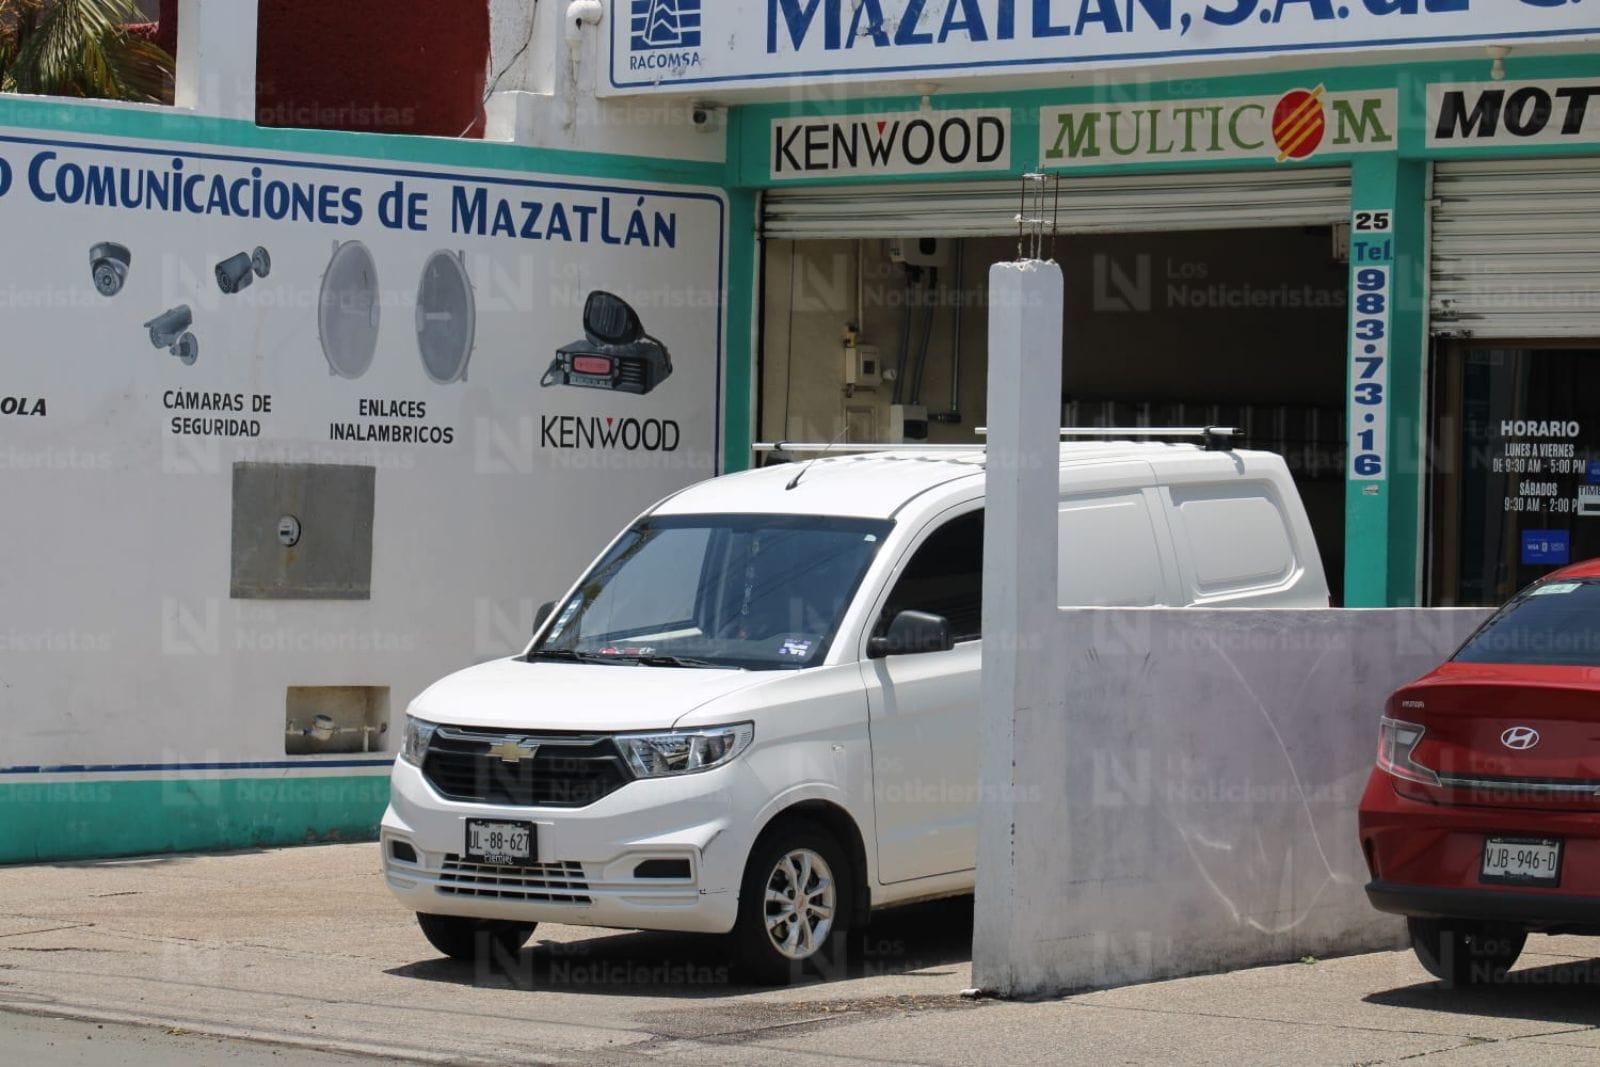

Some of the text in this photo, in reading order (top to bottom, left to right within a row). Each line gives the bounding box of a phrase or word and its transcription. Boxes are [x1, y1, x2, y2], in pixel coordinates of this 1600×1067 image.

[630, 51, 701, 70] RACOMSA
[775, 116, 1005, 172] KENWOOD
[1355, 212, 1389, 230] 25
[252, 395, 272, 412] DE
[358, 399, 426, 418] ENLACES
[171, 417, 261, 437] SEGURIDAD
[330, 422, 454, 444] INALAMBRICOS
[541, 415, 680, 451] KENWOOD
[1500, 420, 1580, 437] HORARIO
[1505, 443, 1575, 457] LUNES A VIERNES
[1493, 458, 1503, 472] DE
[1505, 458, 1525, 473] 9:30
[1527, 458, 1541, 473] AM
[1550, 458, 1570, 473] 5:00
[1572, 459, 1586, 474] PM
[1519, 479, 1558, 496] SÁBADOS
[1504, 496, 1524, 511] 9:30
[1526, 497, 1540, 511] AM
[1549, 498, 1569, 513] 2:00
[1485, 847, 1556, 871] VJB-946-D
